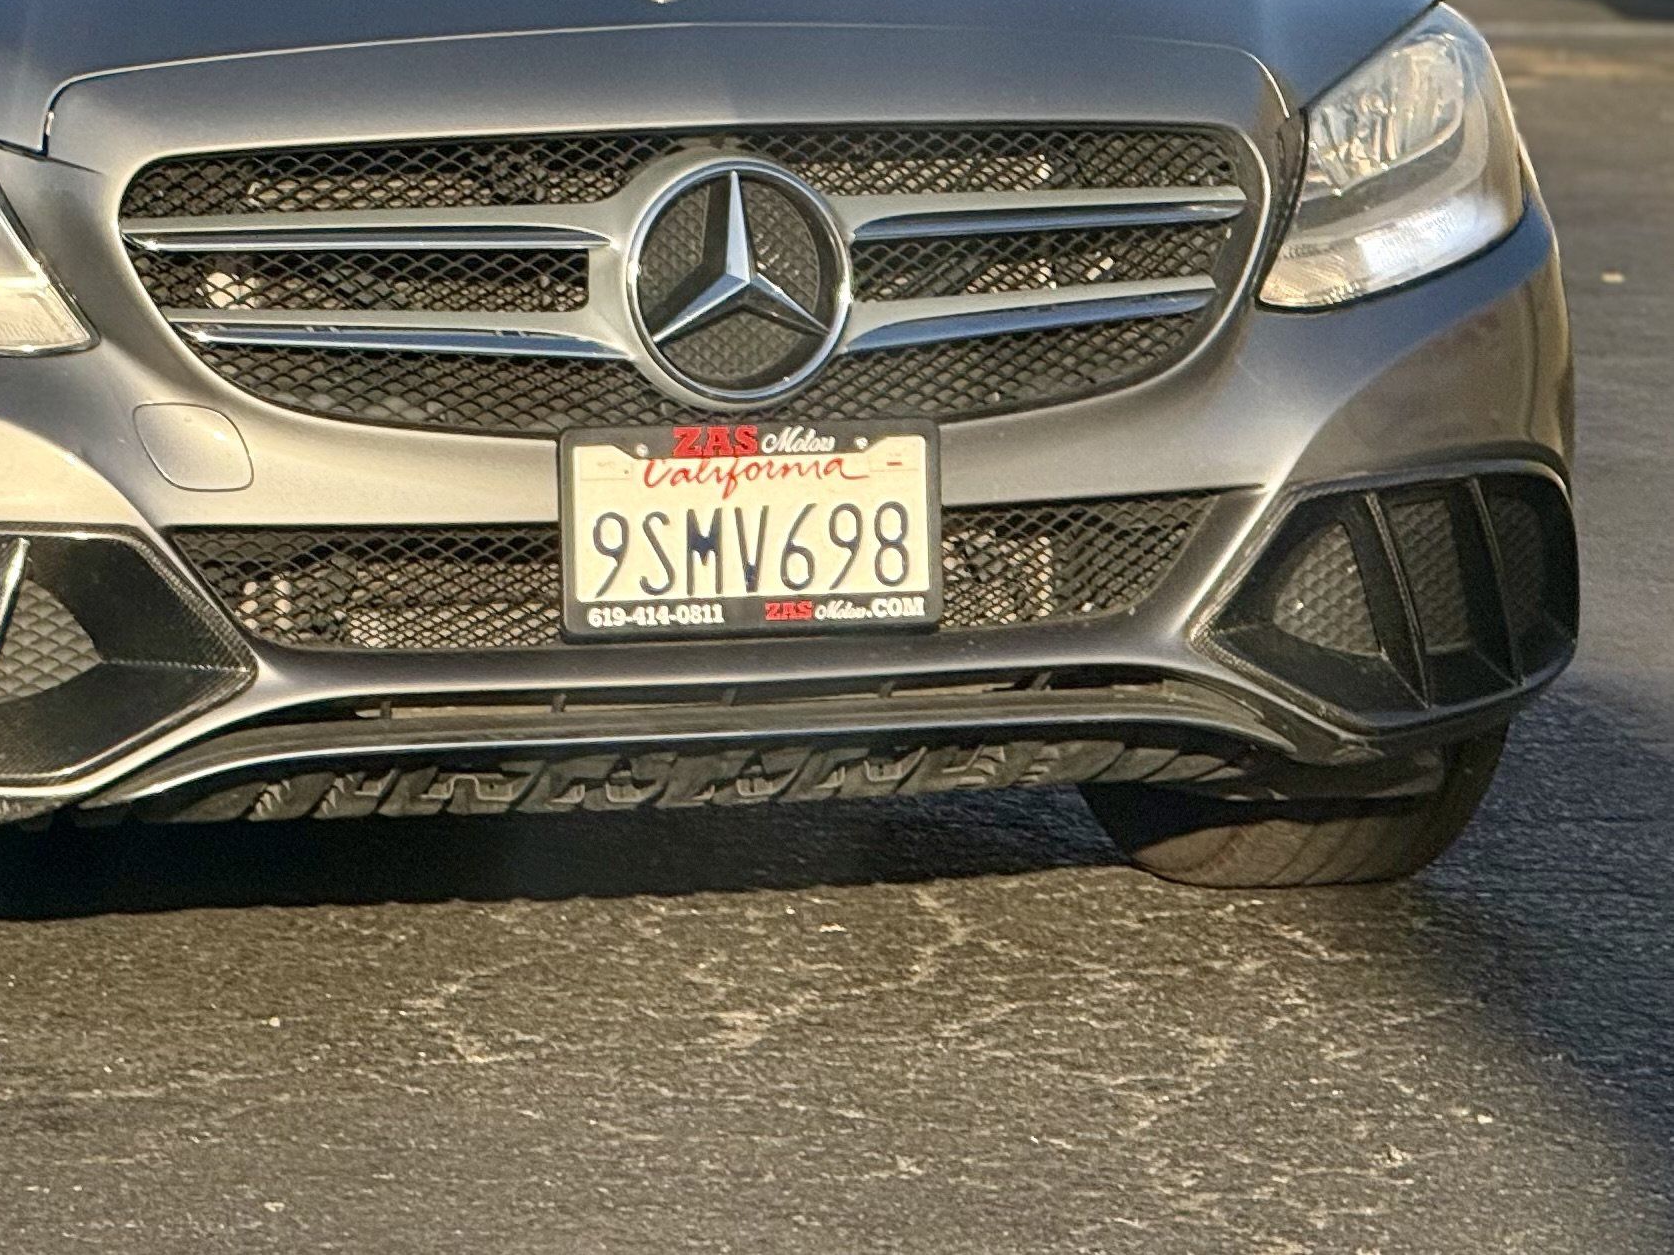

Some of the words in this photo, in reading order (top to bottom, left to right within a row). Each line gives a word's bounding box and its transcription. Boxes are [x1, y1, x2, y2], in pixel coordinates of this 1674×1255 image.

[672, 425, 758, 457] ZAS
[642, 455, 870, 500] California
[592, 501, 910, 599] 9SMV698
[587, 603, 725, 628] 619-414-0811
